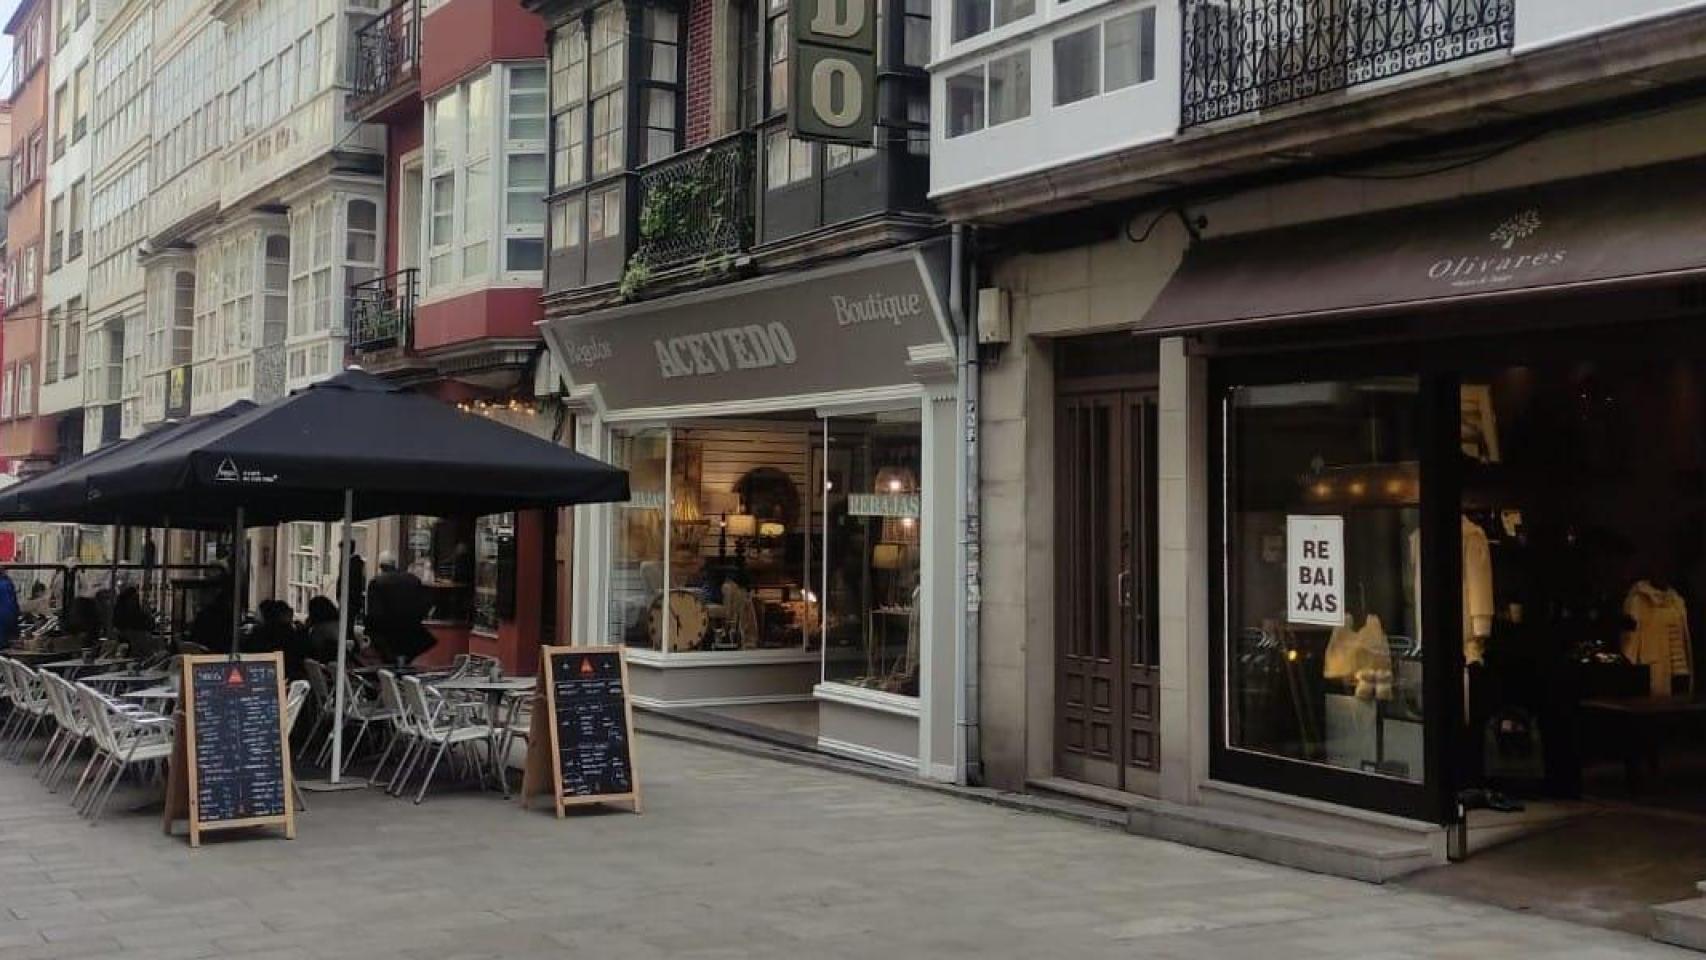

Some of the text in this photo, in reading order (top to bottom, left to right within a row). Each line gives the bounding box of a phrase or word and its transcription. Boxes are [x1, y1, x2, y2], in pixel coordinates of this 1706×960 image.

[1428, 250, 1567, 279] Olivares
[832, 294, 920, 326] Boutique
[654, 321, 797, 378] ACEVEDO
[1303, 540, 1330, 559] RE
[1298, 566, 1334, 587] BAI
[1296, 591, 1337, 614] XAS
